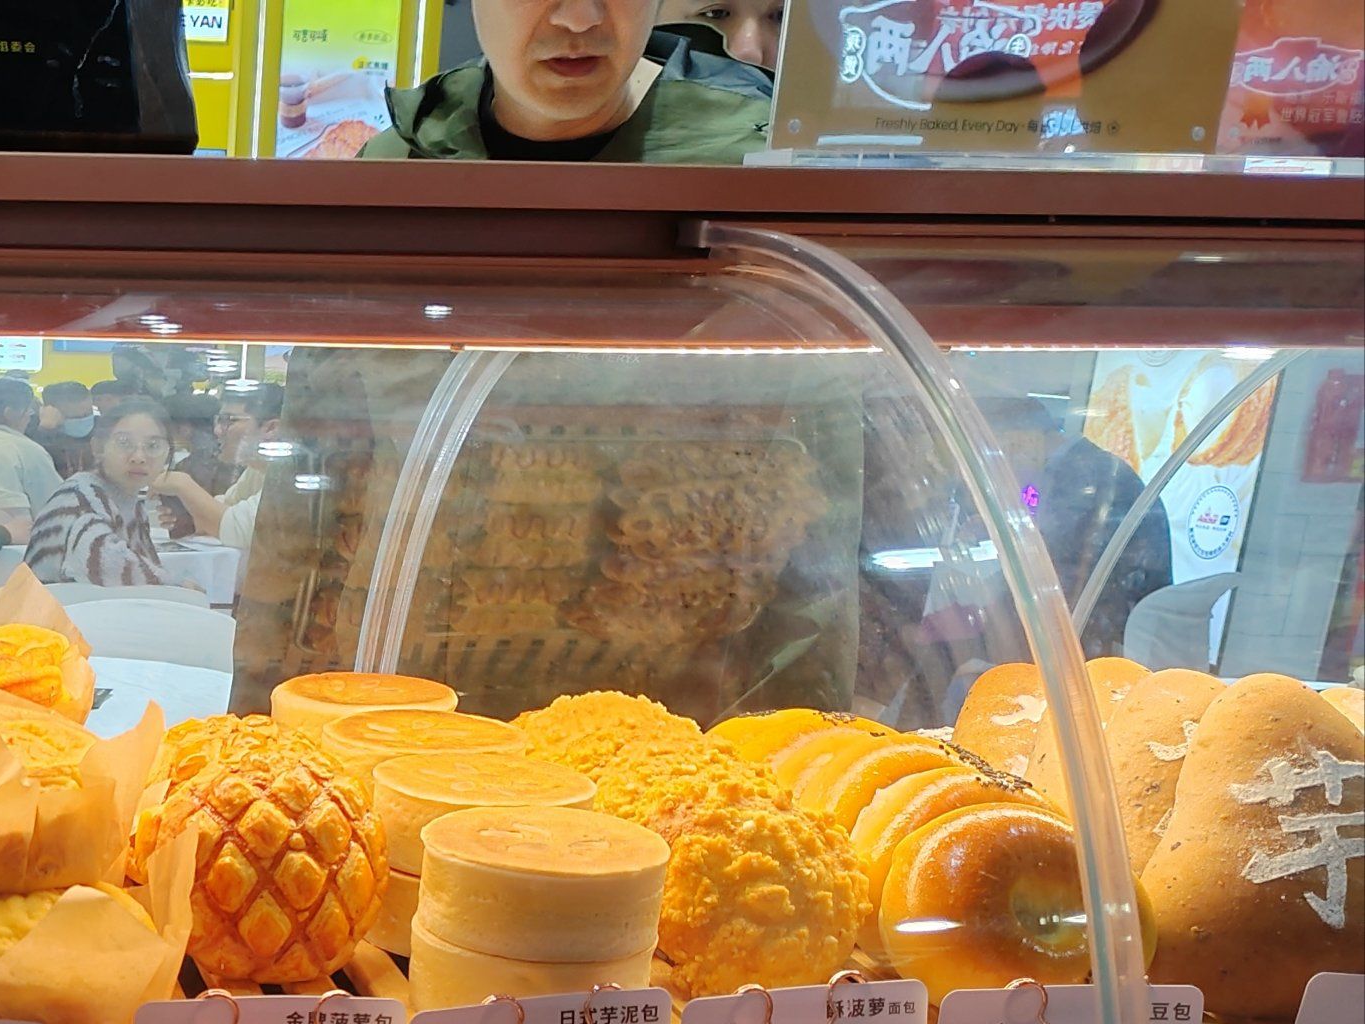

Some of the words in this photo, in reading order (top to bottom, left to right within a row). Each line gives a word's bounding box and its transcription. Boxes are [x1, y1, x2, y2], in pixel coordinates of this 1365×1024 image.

[875, 117, 916, 132] Freshly
[920, 118, 960, 133] Baked,
[962, 119, 994, 134] Every
[996, 119, 1019, 135] Day
